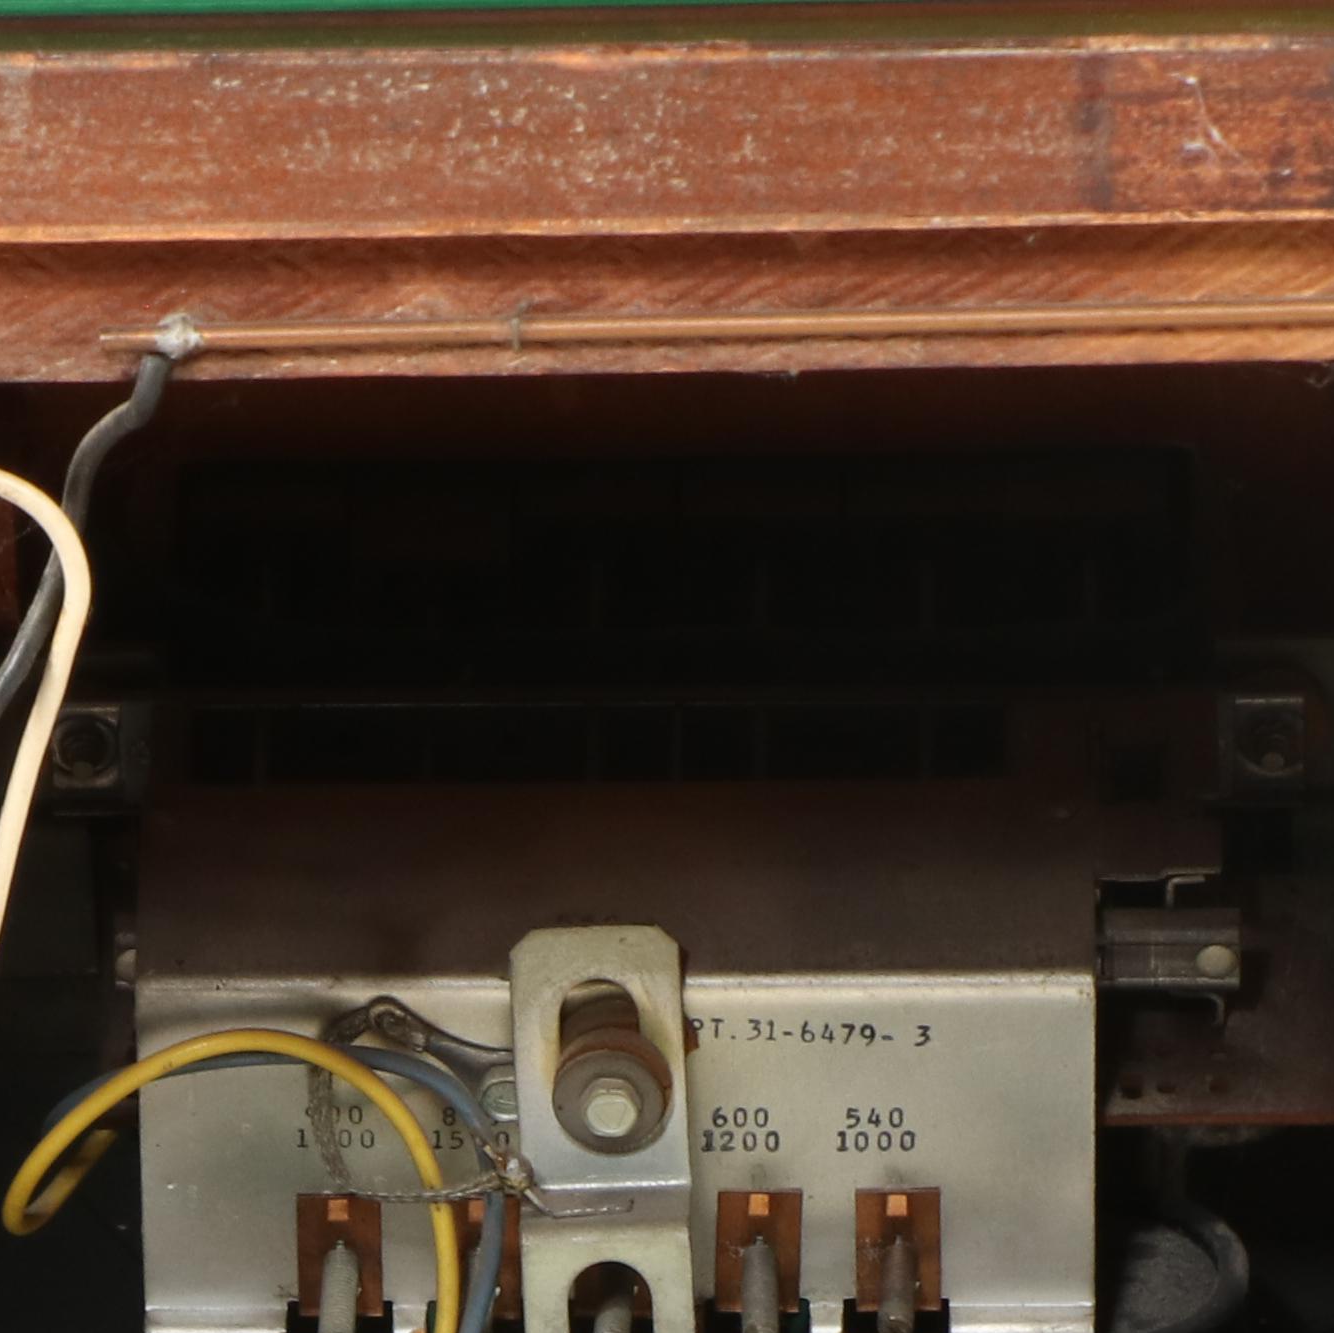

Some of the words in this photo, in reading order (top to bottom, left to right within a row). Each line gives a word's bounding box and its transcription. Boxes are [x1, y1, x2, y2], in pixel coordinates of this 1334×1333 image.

[711, 1107, 770, 1128] 600
[844, 1107, 905, 1128] 540
[296, 1129, 375, 1149] 100
[701, 1131, 780, 1152] 1200
[836, 1131, 916, 1152] 1000
